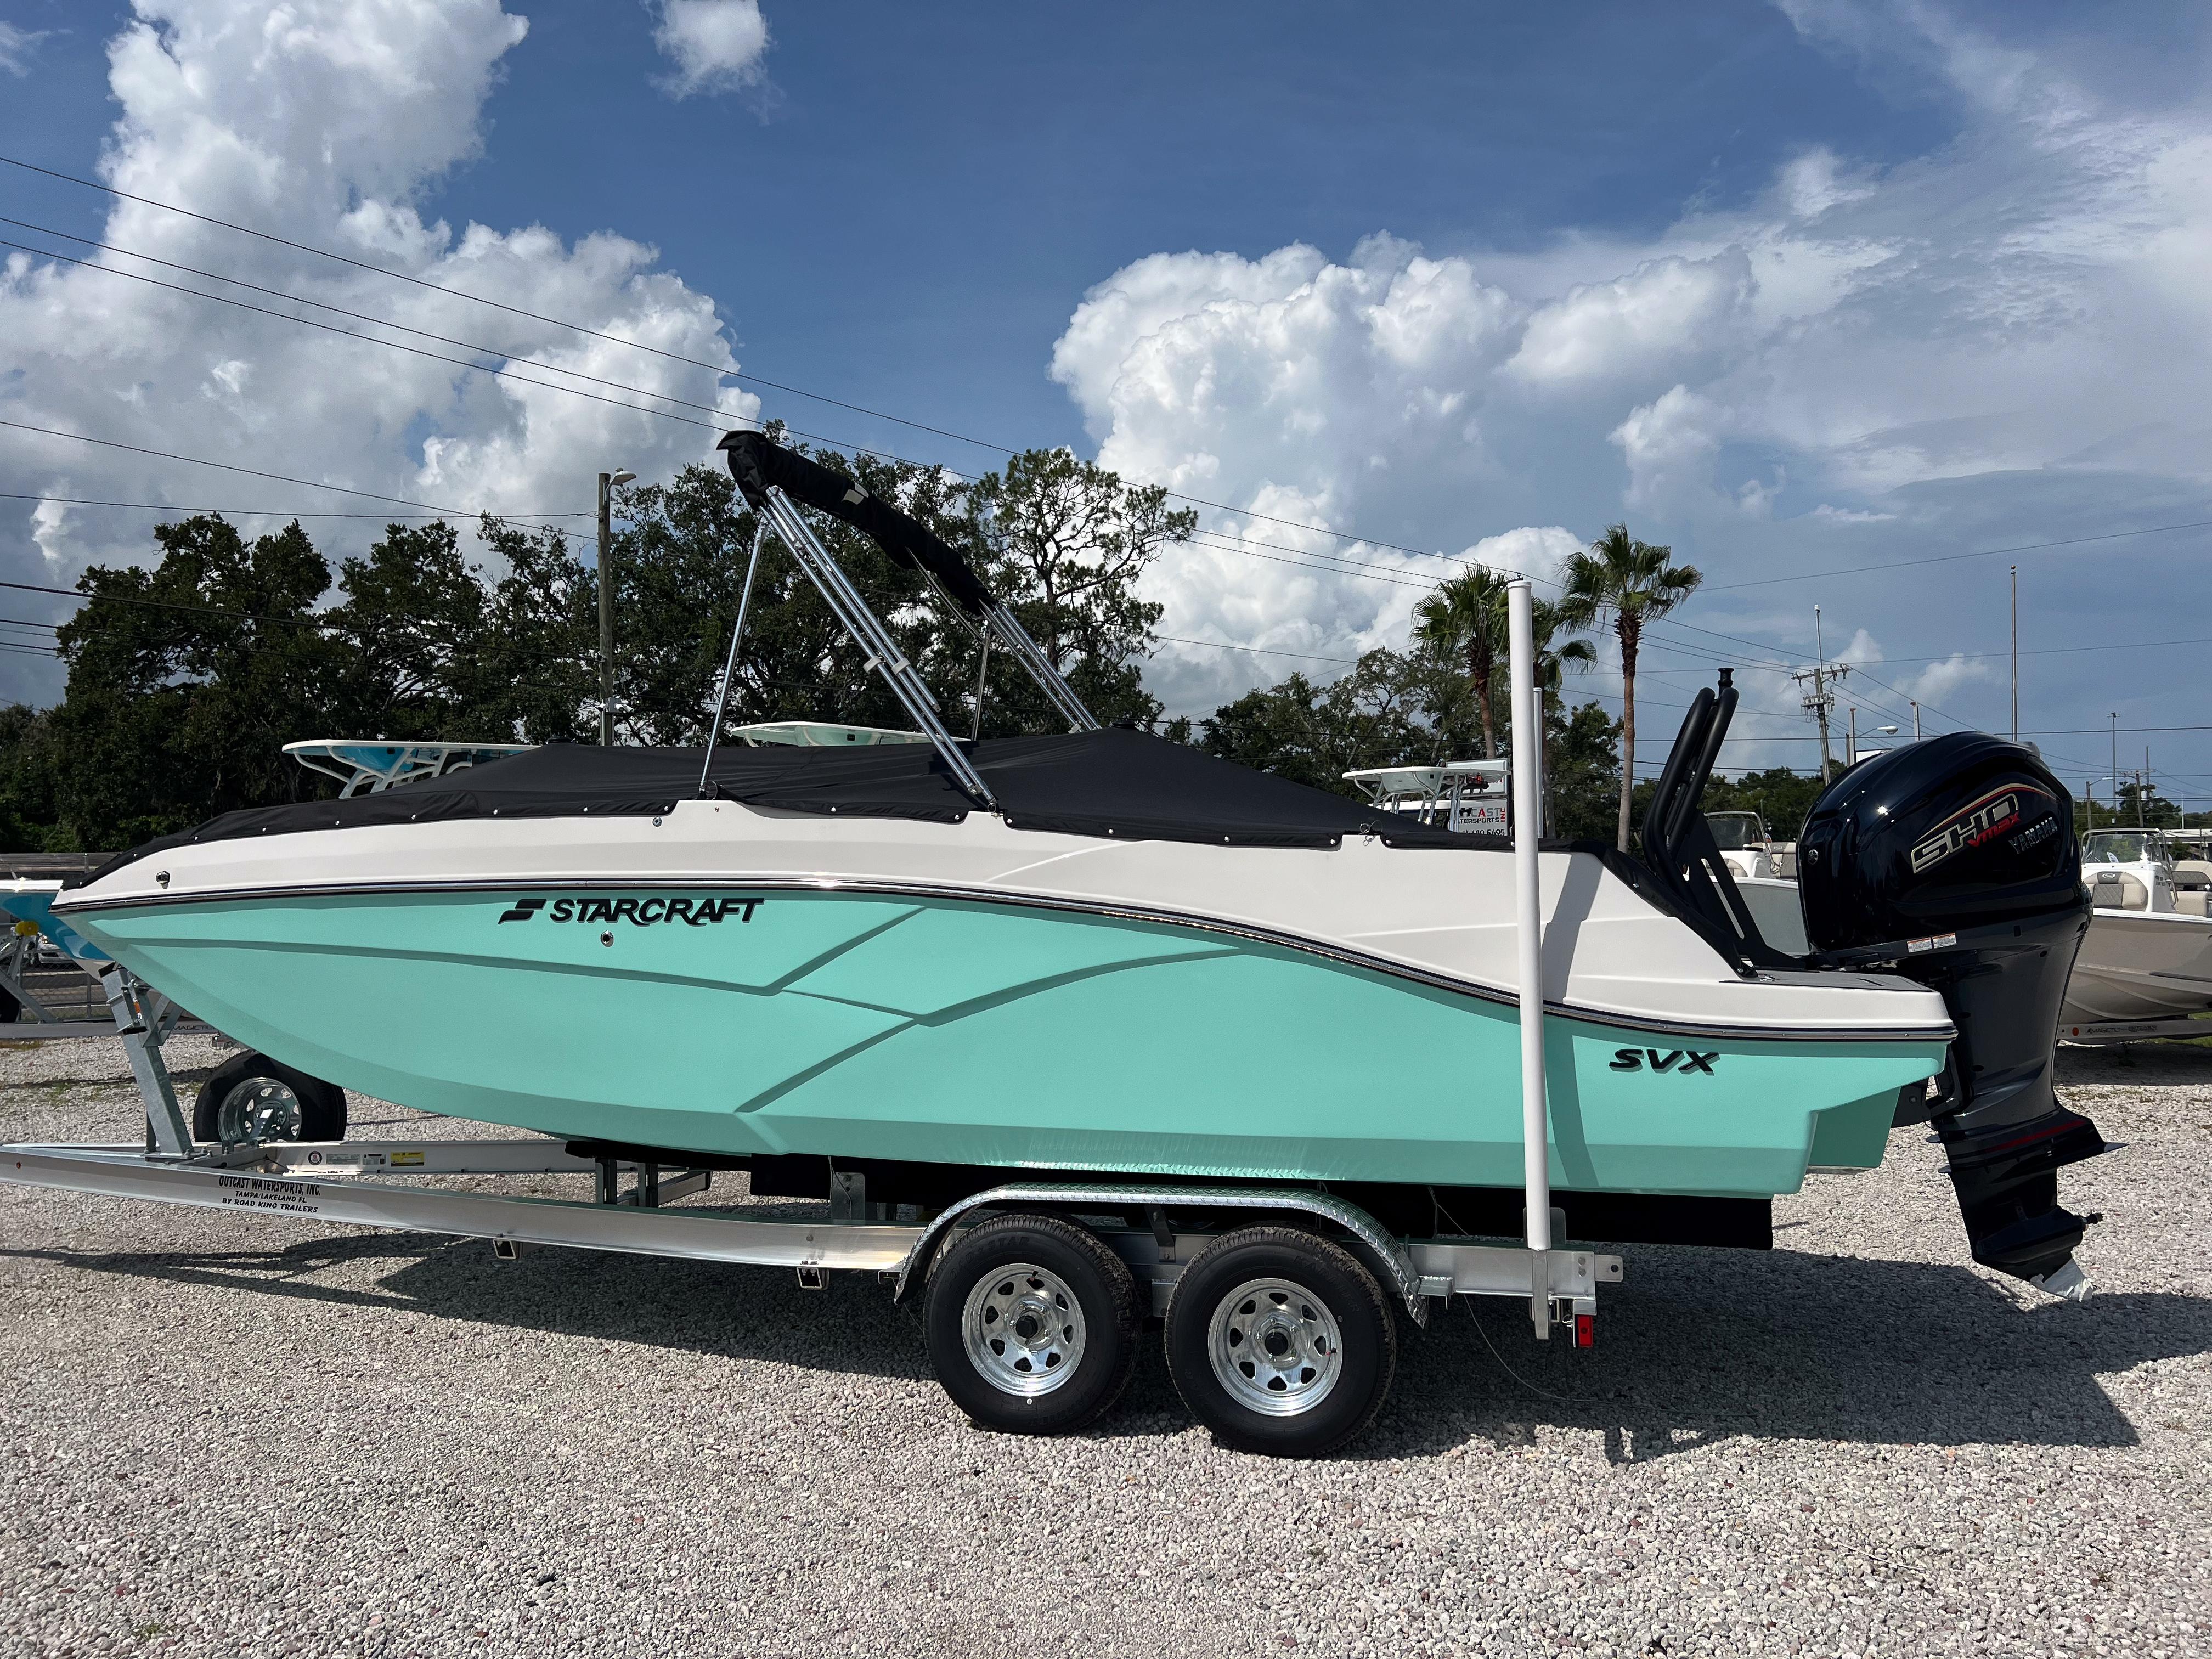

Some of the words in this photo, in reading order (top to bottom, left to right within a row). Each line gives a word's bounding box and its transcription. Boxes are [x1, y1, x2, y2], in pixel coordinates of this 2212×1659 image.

[1911, 793, 2019, 873] SHO
[2008, 816, 2057, 854] YAMAHA
[549, 898, 764, 927] STARCRAFT
[1609, 1048, 1720, 1076] SVX
[219, 1176, 249, 1189] OUTCAST
[251, 1178, 304, 1196] WATERSPORTS,
[306, 1184, 321, 1196] INC.
[235, 1191, 296, 1202] TAMPA/LAKELAND
[280, 1204, 318, 1213] TRAILERS
